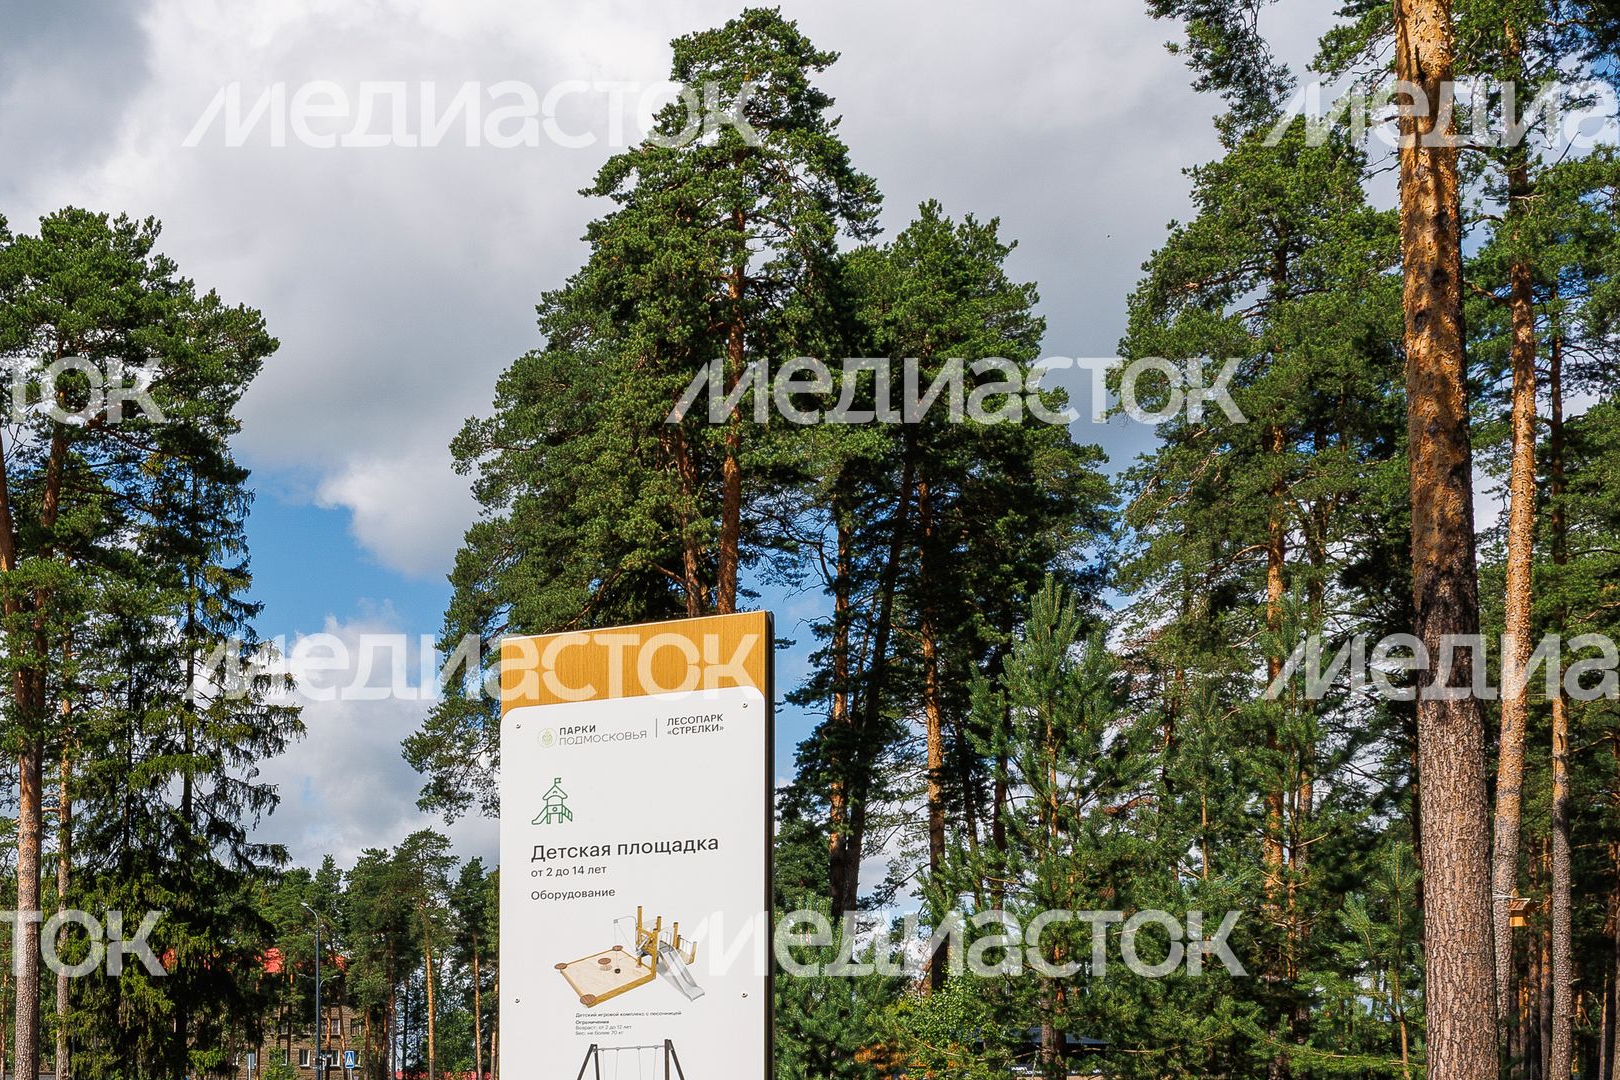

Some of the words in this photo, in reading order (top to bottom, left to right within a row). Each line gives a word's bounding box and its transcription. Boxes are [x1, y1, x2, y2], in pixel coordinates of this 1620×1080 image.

[667, 714, 723, 726] ЛЕСОПАРК
[559, 725, 596, 735] ПАРКИ
[667, 724, 724, 736] «СТРЕЛКИ»
[559, 730, 647, 746] ПОДМОСКОВЬЯ
[531, 844, 611, 863] Детская
[617, 838, 719, 855] площадка
[531, 869, 544, 877] от
[546, 868, 553, 877] 2
[555, 868, 570, 877] до
[572, 866, 585, 875] 14
[588, 866, 607, 875] лет
[531, 888, 616, 901] Оборудование
